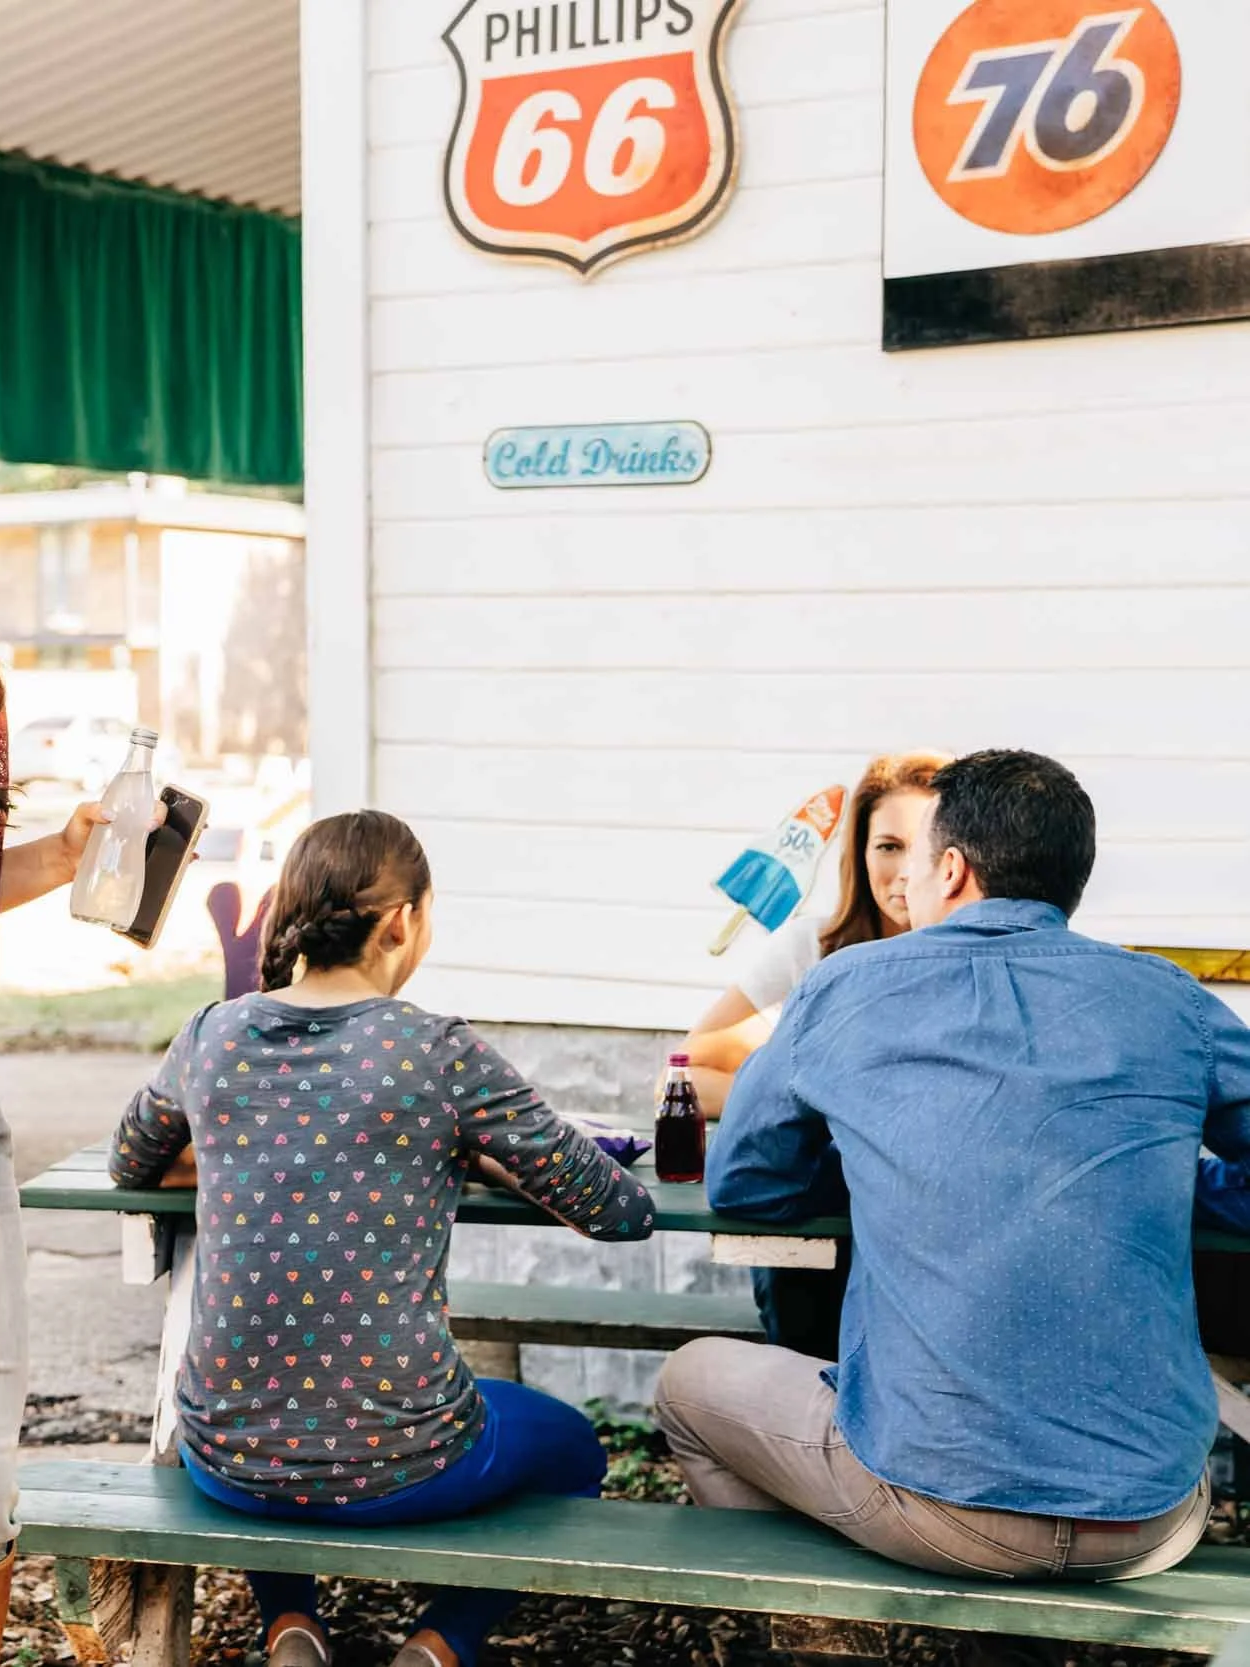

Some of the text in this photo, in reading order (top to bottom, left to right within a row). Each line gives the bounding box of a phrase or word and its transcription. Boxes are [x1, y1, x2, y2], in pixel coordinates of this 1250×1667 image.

[485, 0, 693, 62] PHILLIPS
[493, 77, 677, 207] 66
[946, 8, 1145, 183] 76
[493, 435, 698, 478] Cold Drinks
